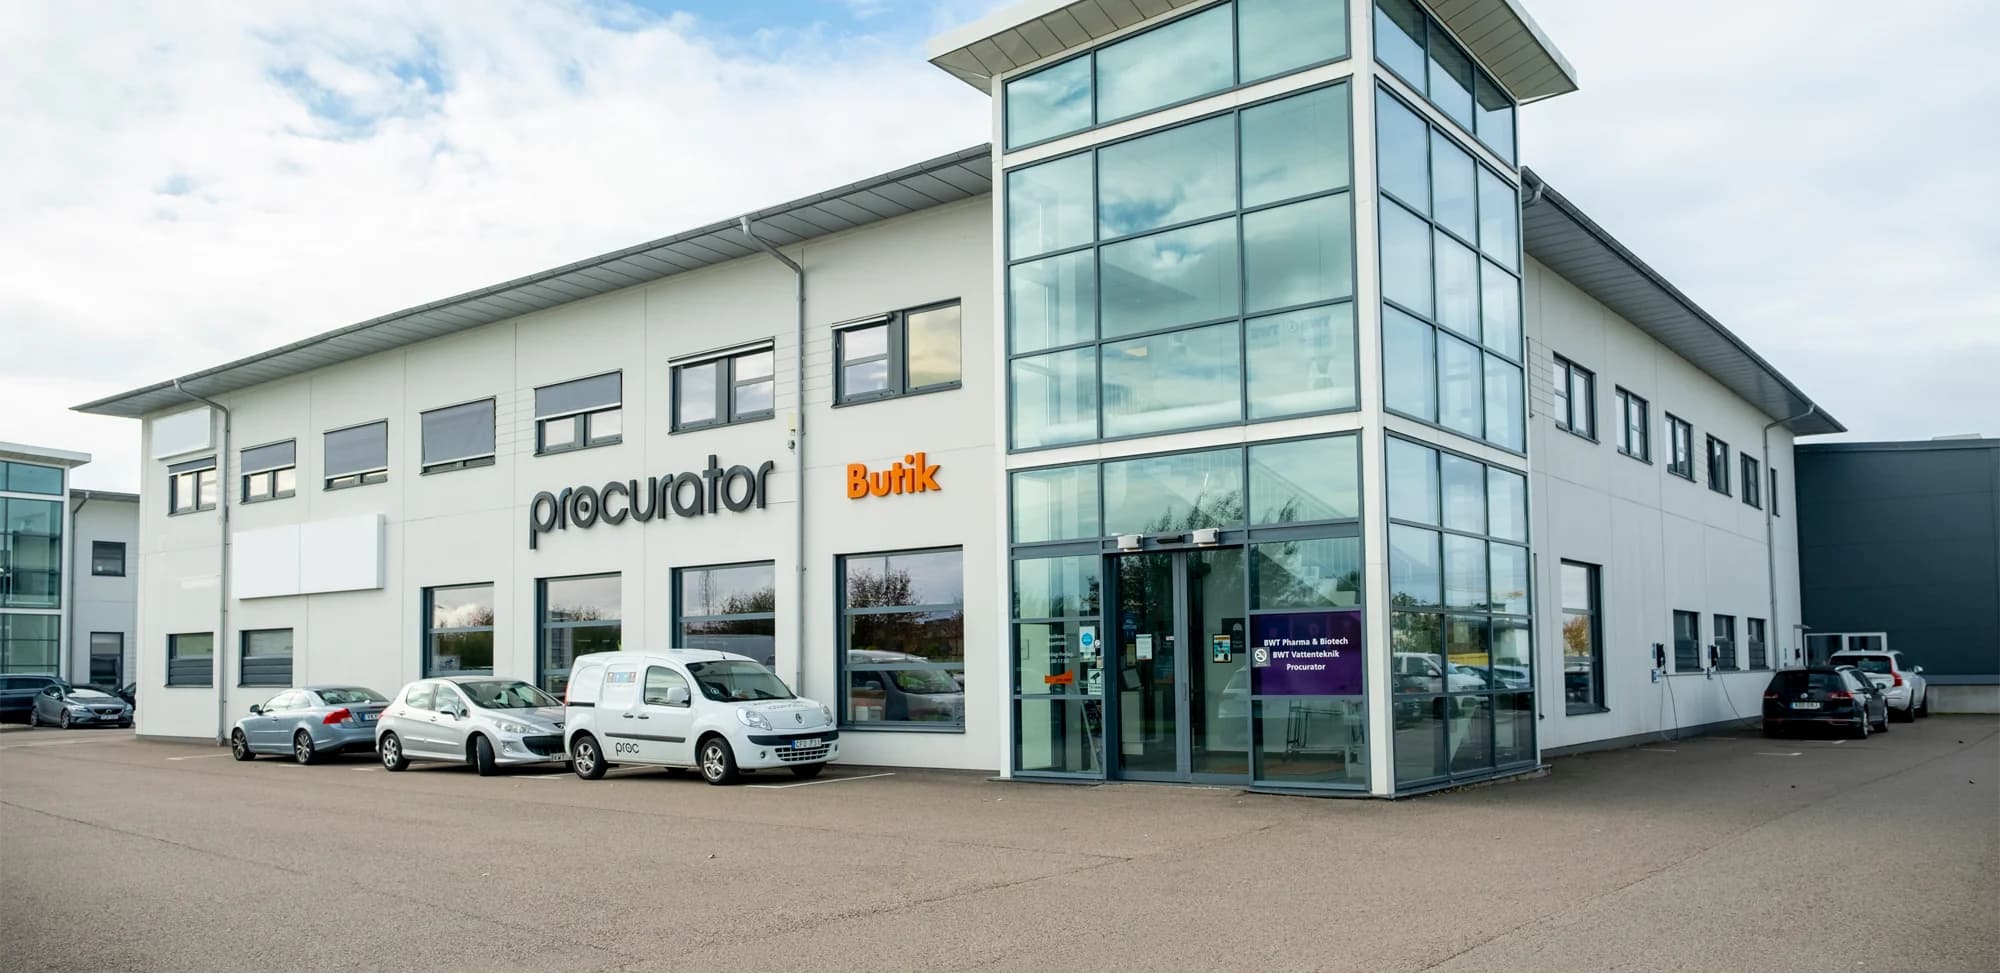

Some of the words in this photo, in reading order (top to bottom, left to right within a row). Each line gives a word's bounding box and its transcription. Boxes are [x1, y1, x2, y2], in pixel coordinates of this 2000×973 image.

[846, 452, 942, 499] Butik
[529, 454, 774, 550] procurator
[1282, 638, 1310, 646] Pharma
[1320, 637, 1349, 645] Biotech
[1272, 651, 1290, 659] BWT
[1291, 650, 1340, 658] Vattenteknik
[1286, 663, 1326, 671] Procurator
